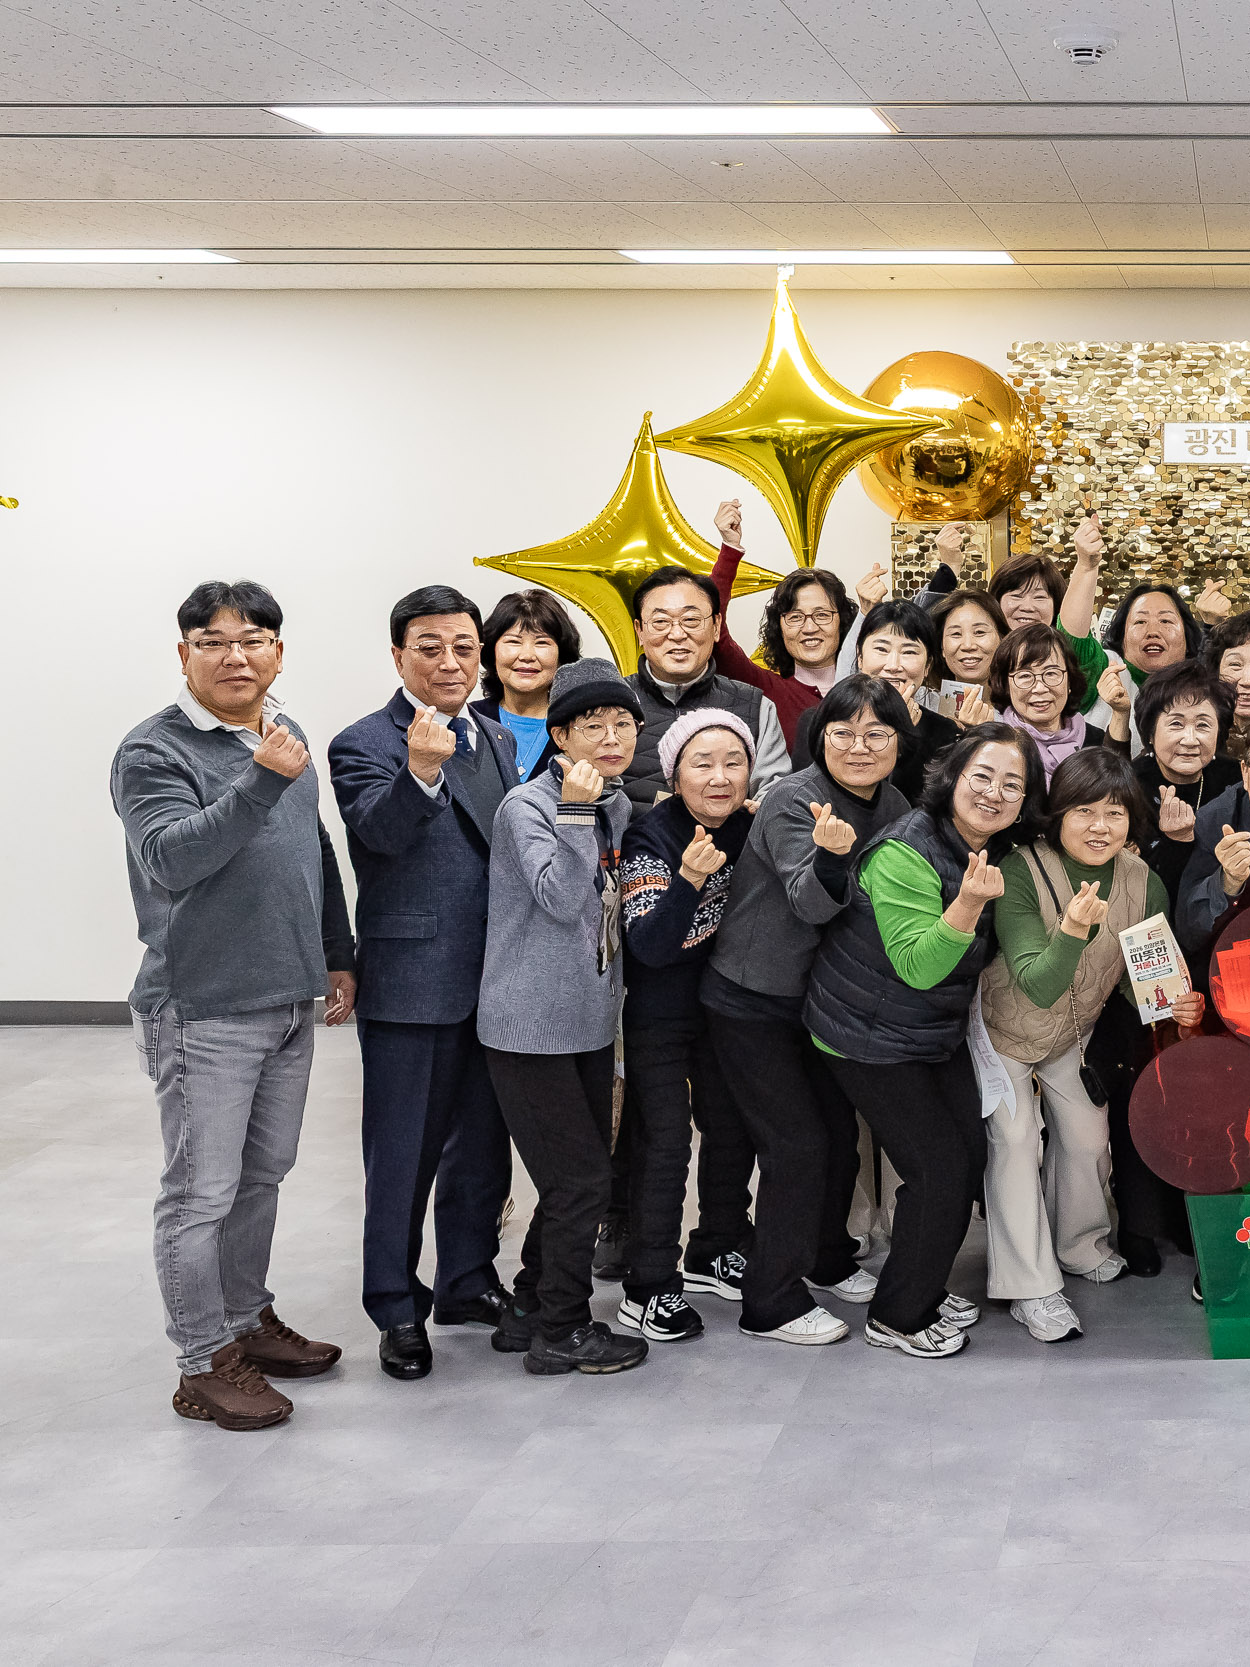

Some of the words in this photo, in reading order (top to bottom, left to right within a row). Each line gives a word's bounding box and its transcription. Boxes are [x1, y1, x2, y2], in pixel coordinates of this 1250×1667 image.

[1184, 428, 1237, 456] 광진
[1130, 945, 1168, 963] 따뜻한
[1134, 956, 1170, 971] 겨울나기
